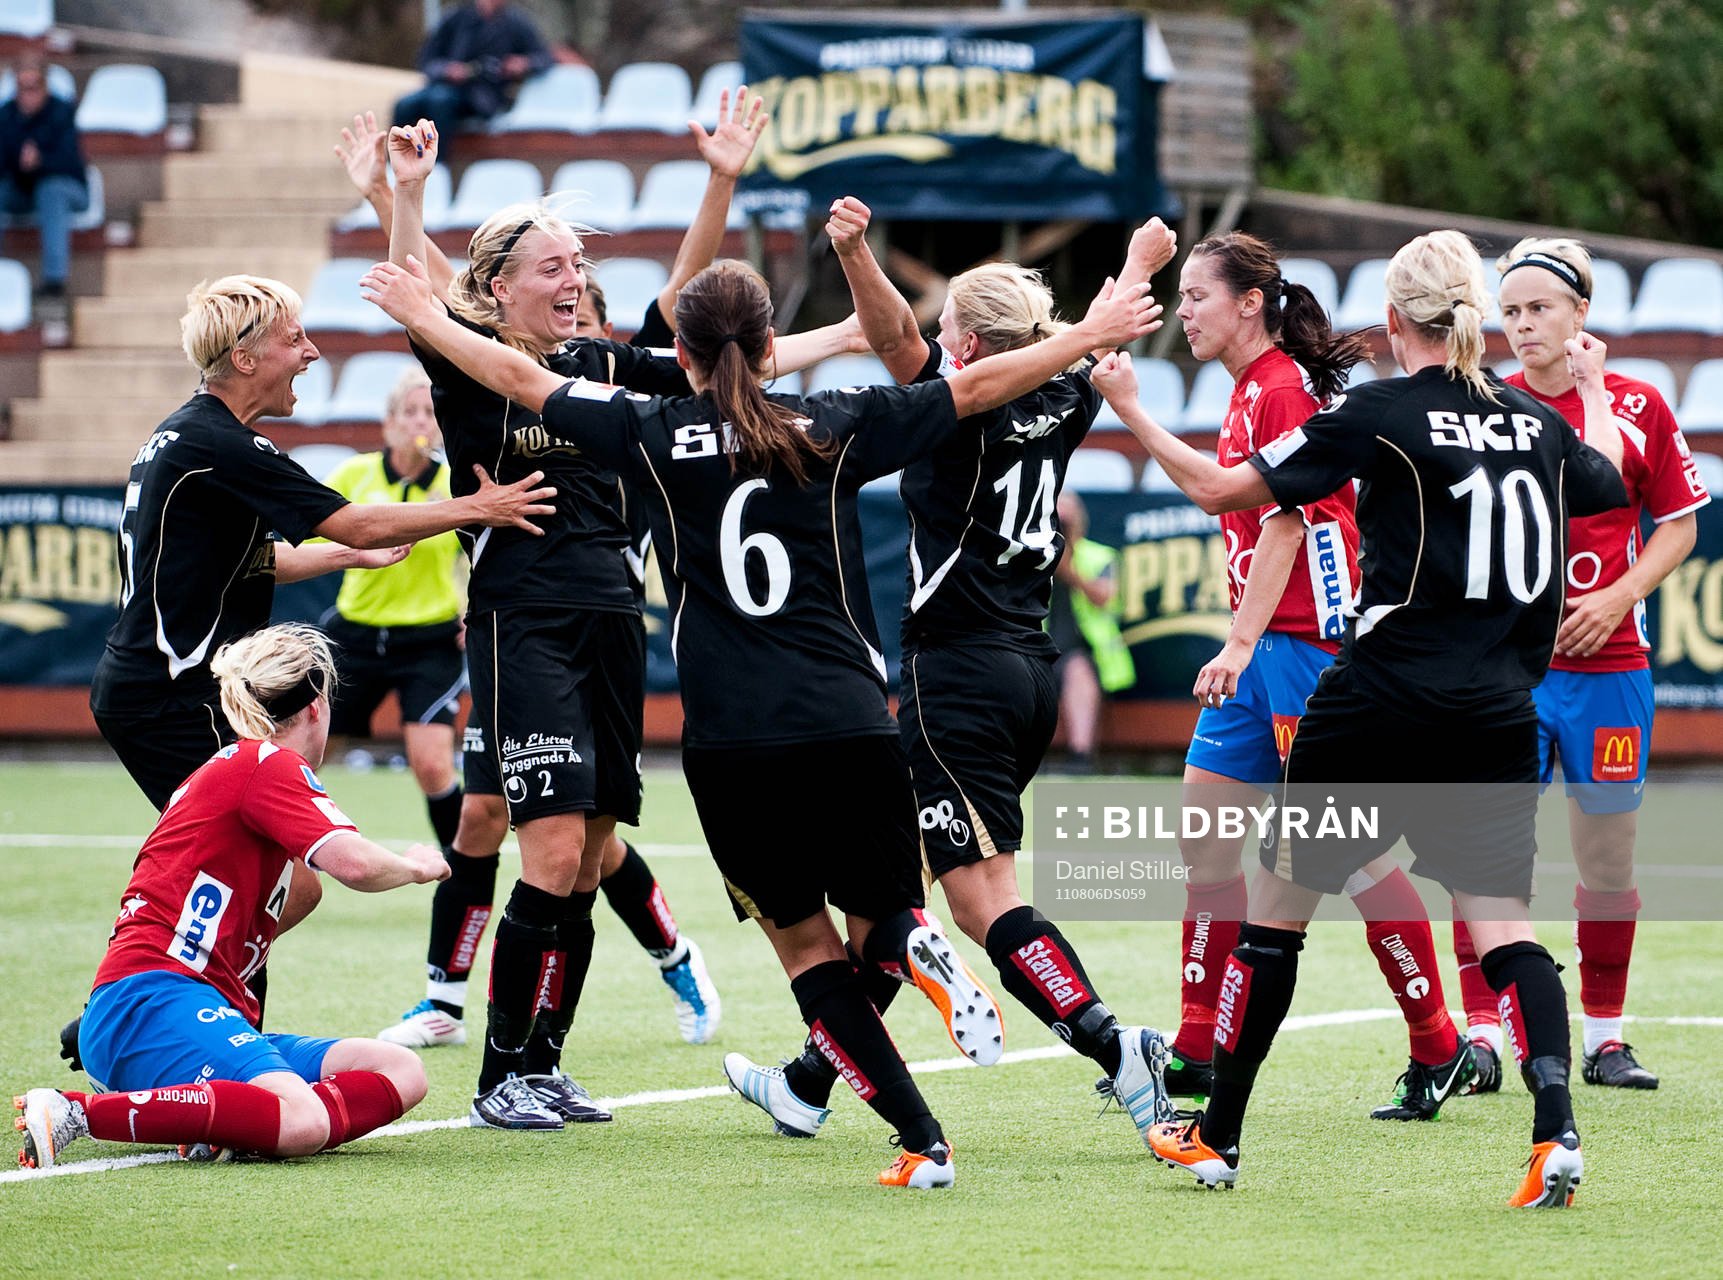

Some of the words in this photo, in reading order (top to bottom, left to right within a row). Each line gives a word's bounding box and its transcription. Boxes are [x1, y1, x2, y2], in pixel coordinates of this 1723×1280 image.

[1426, 411, 1544, 452] SKF
[993, 459, 1057, 571] 14
[1449, 464, 1553, 605] 10
[720, 478, 792, 617] 6
[502, 751, 565, 775] Byggnads
[525, 733, 574, 748] Ekstrand
[537, 769, 554, 797] 2
[1189, 911, 1213, 960] COMFORT
[1381, 933, 1420, 977] COMFORT
[1018, 940, 1083, 1009] Stavdal
[1214, 963, 1244, 1045] Stavda
[813, 1030, 870, 1096] Stavdal
[156, 1089, 209, 1105] OMFORT
